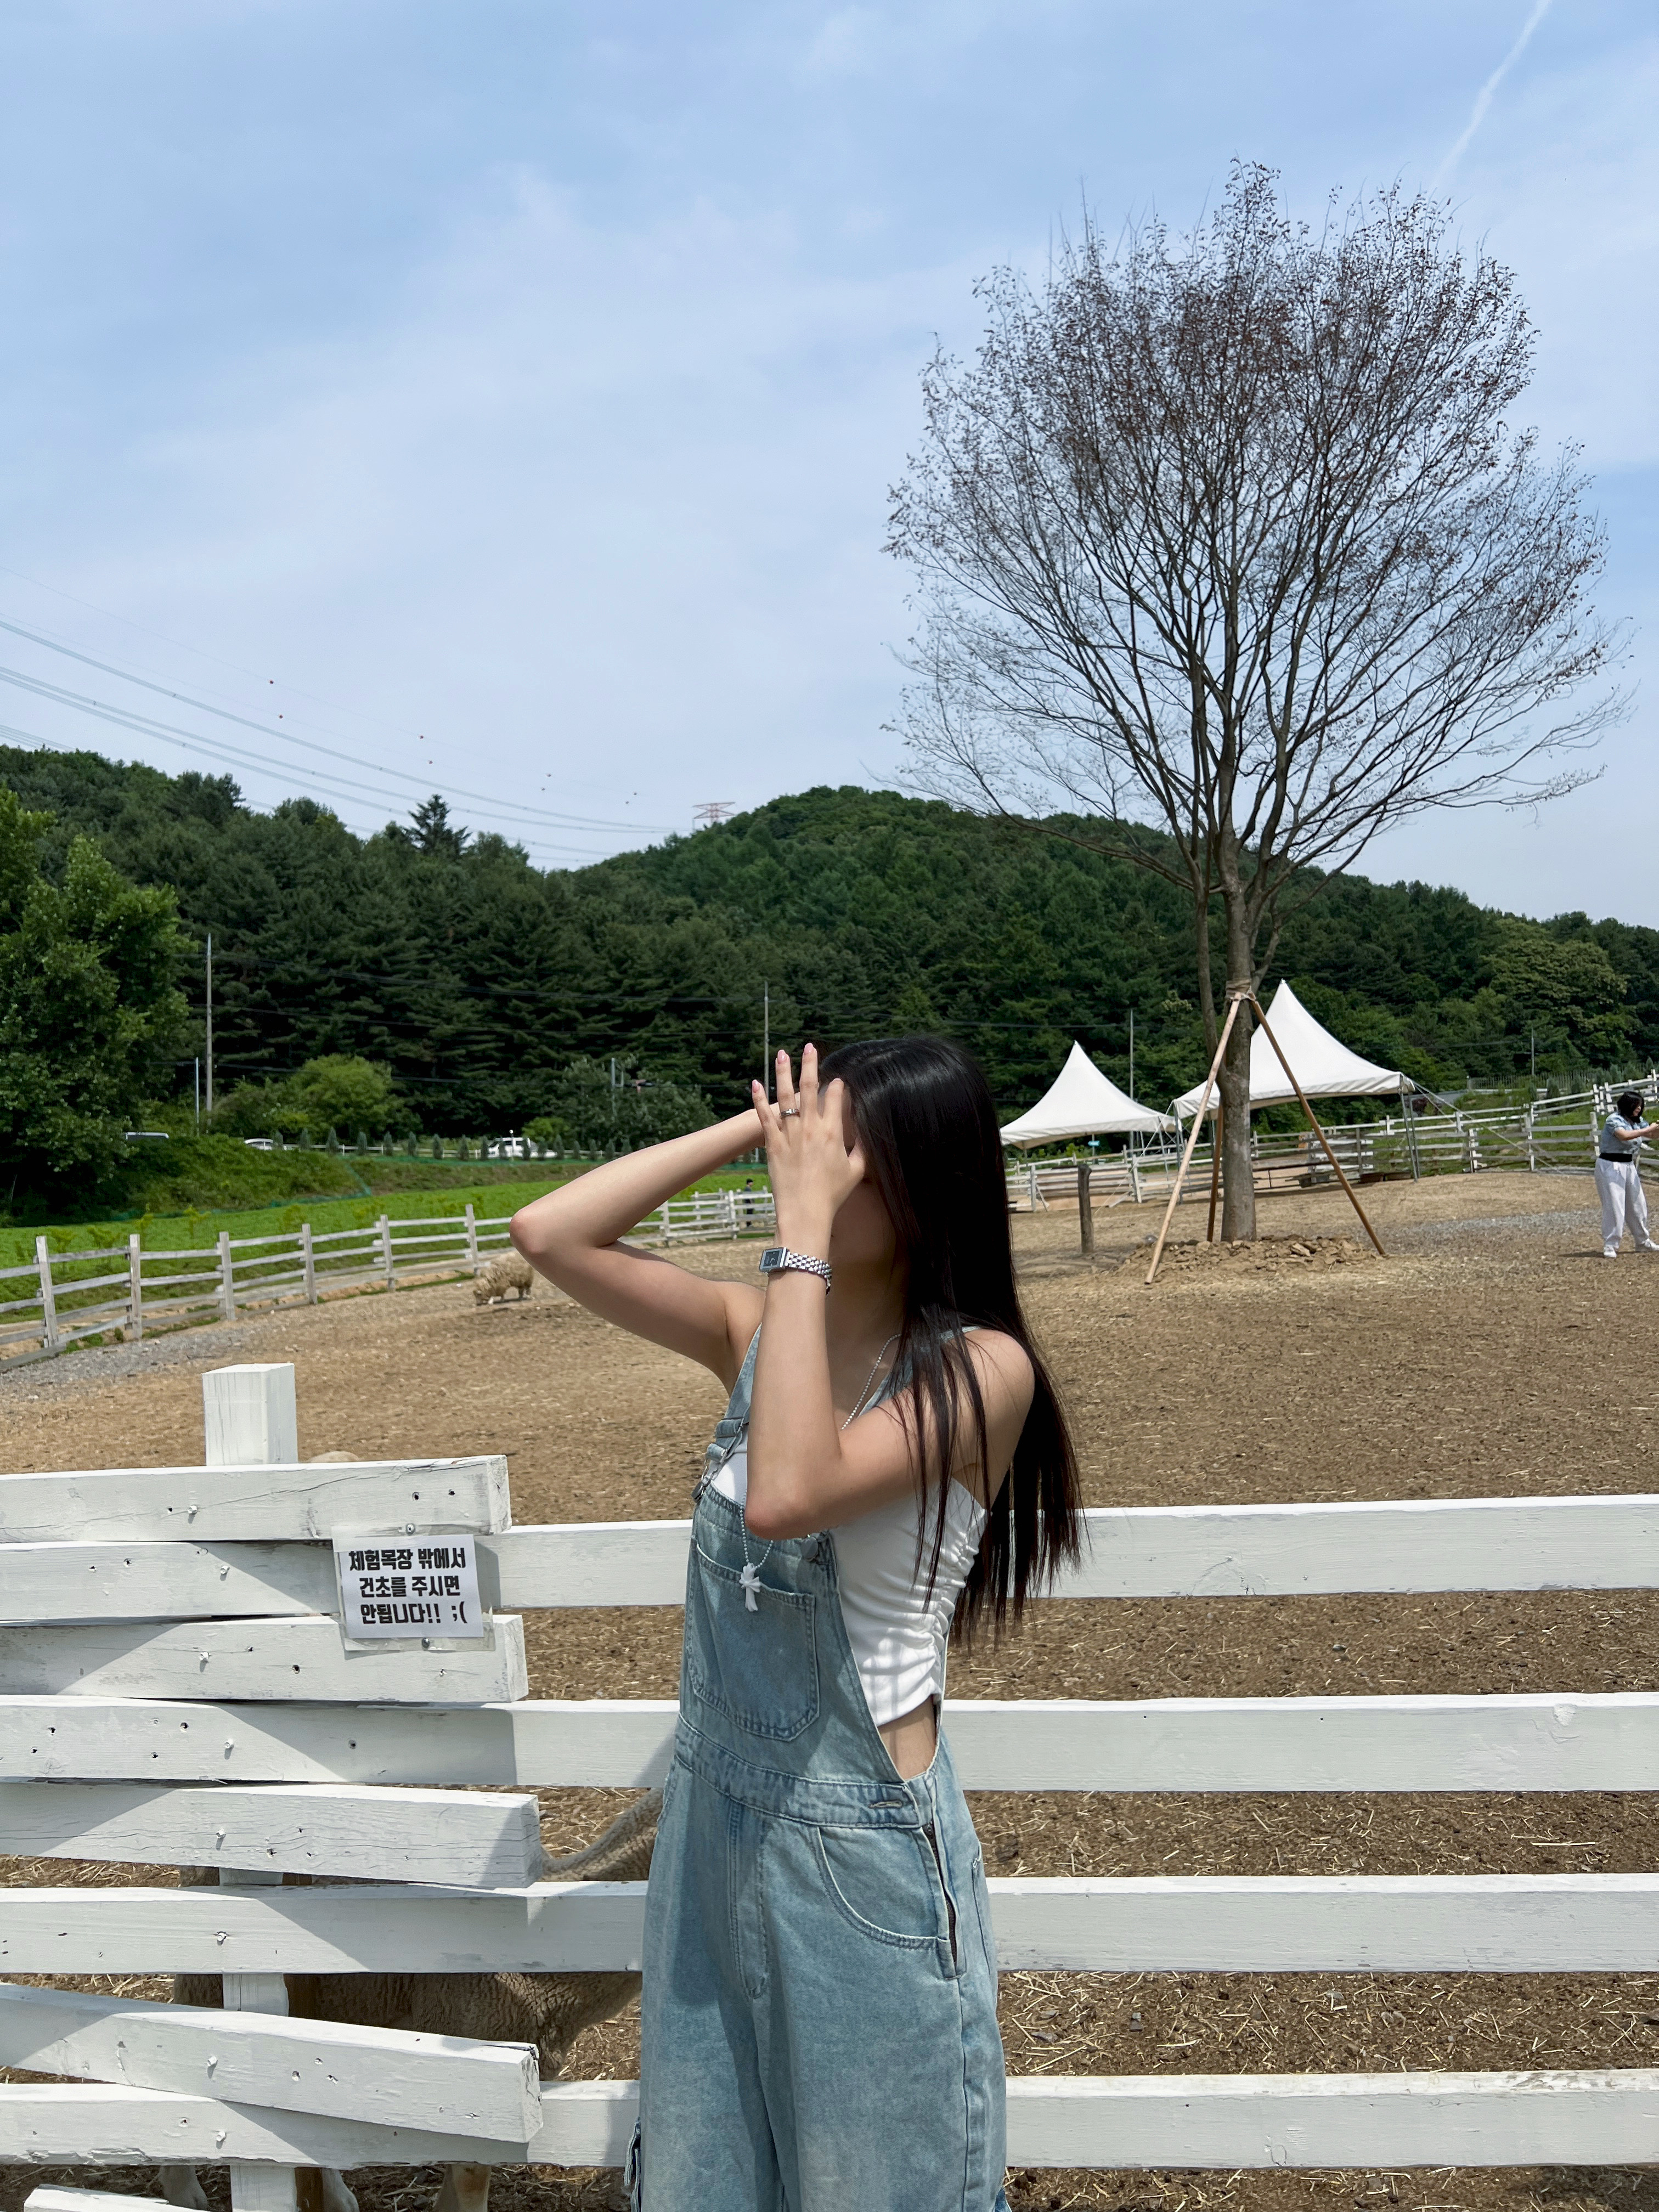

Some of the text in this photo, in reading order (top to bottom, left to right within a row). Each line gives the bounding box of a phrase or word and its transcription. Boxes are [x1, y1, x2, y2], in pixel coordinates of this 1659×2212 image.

[348, 1547, 466, 1571] 체험목장 밖에서
[359, 1575, 461, 1598] 건초를 주시면
[360, 1604, 441, 1624] 안됩니다!!
